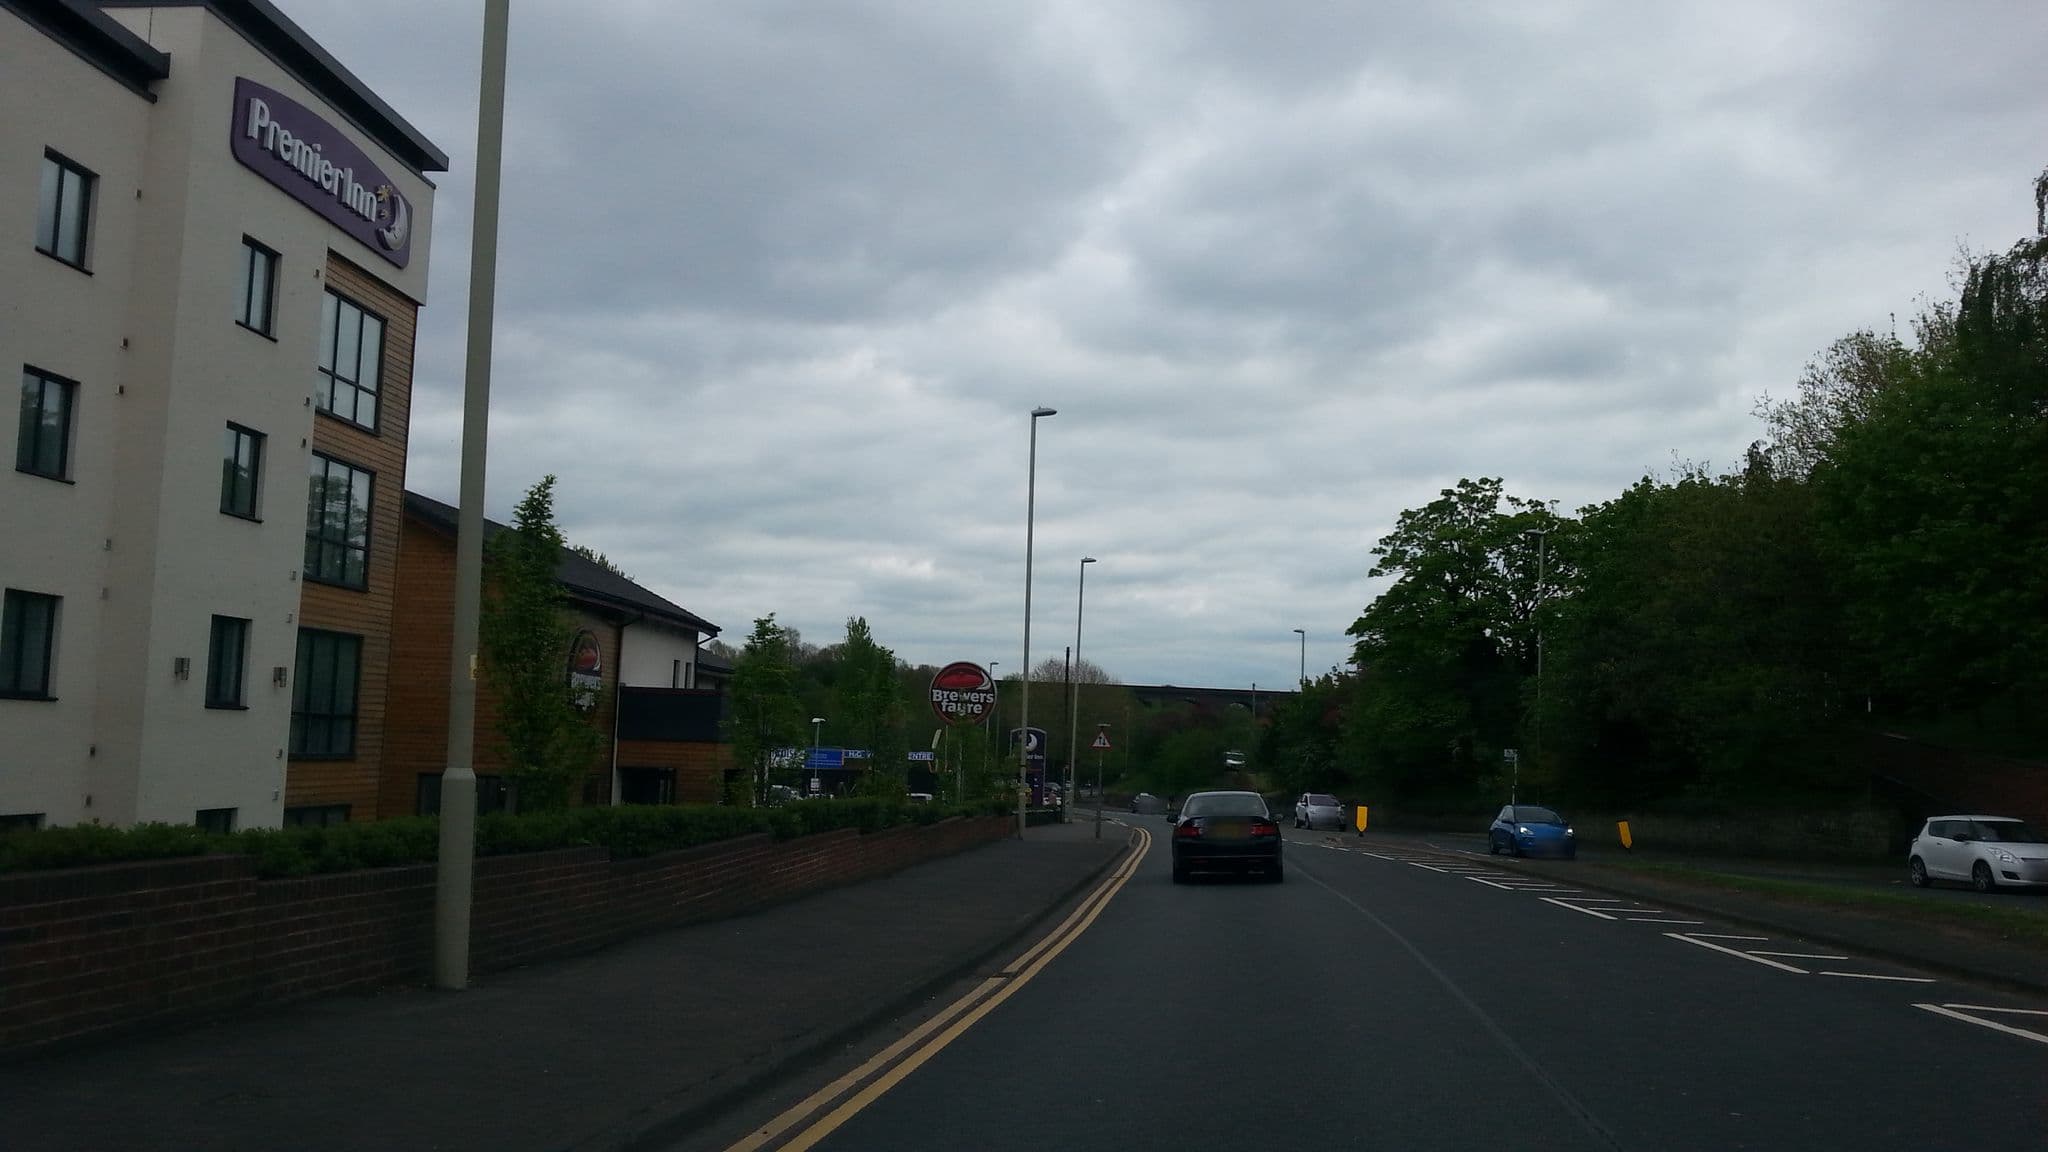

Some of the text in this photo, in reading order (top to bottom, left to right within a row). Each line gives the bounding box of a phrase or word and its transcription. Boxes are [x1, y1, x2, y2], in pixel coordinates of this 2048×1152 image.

[247, 97, 377, 222] Premier Inn
[932, 689, 995, 703] Brewers
[941, 699, 983, 716] fayre
